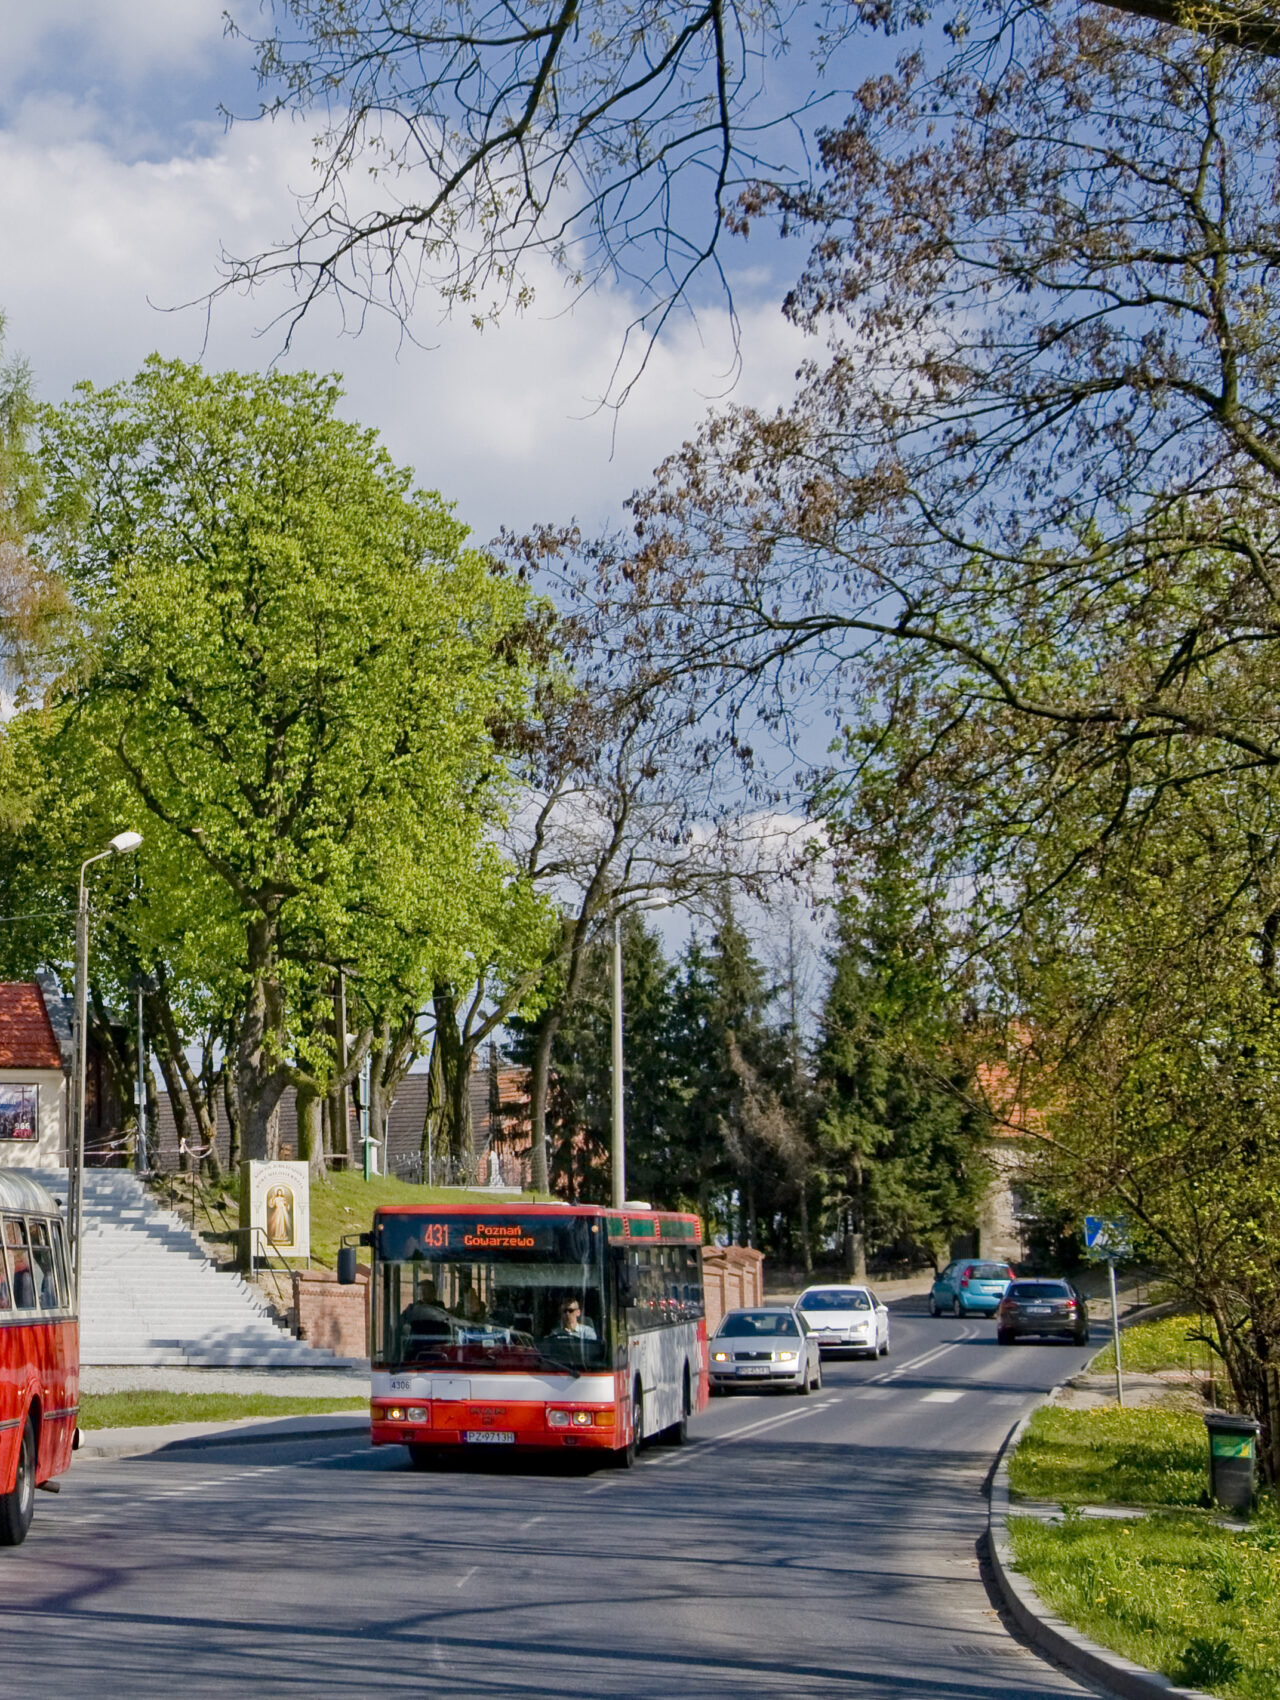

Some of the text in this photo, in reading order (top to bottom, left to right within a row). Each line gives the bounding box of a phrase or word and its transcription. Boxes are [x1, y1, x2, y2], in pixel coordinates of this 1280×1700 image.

[424, 1223, 449, 1247] 431
[476, 1224, 522, 1236] Poznań
[464, 1235, 535, 1247] Gowarzewo
[391, 1381, 410, 1390] 4306
